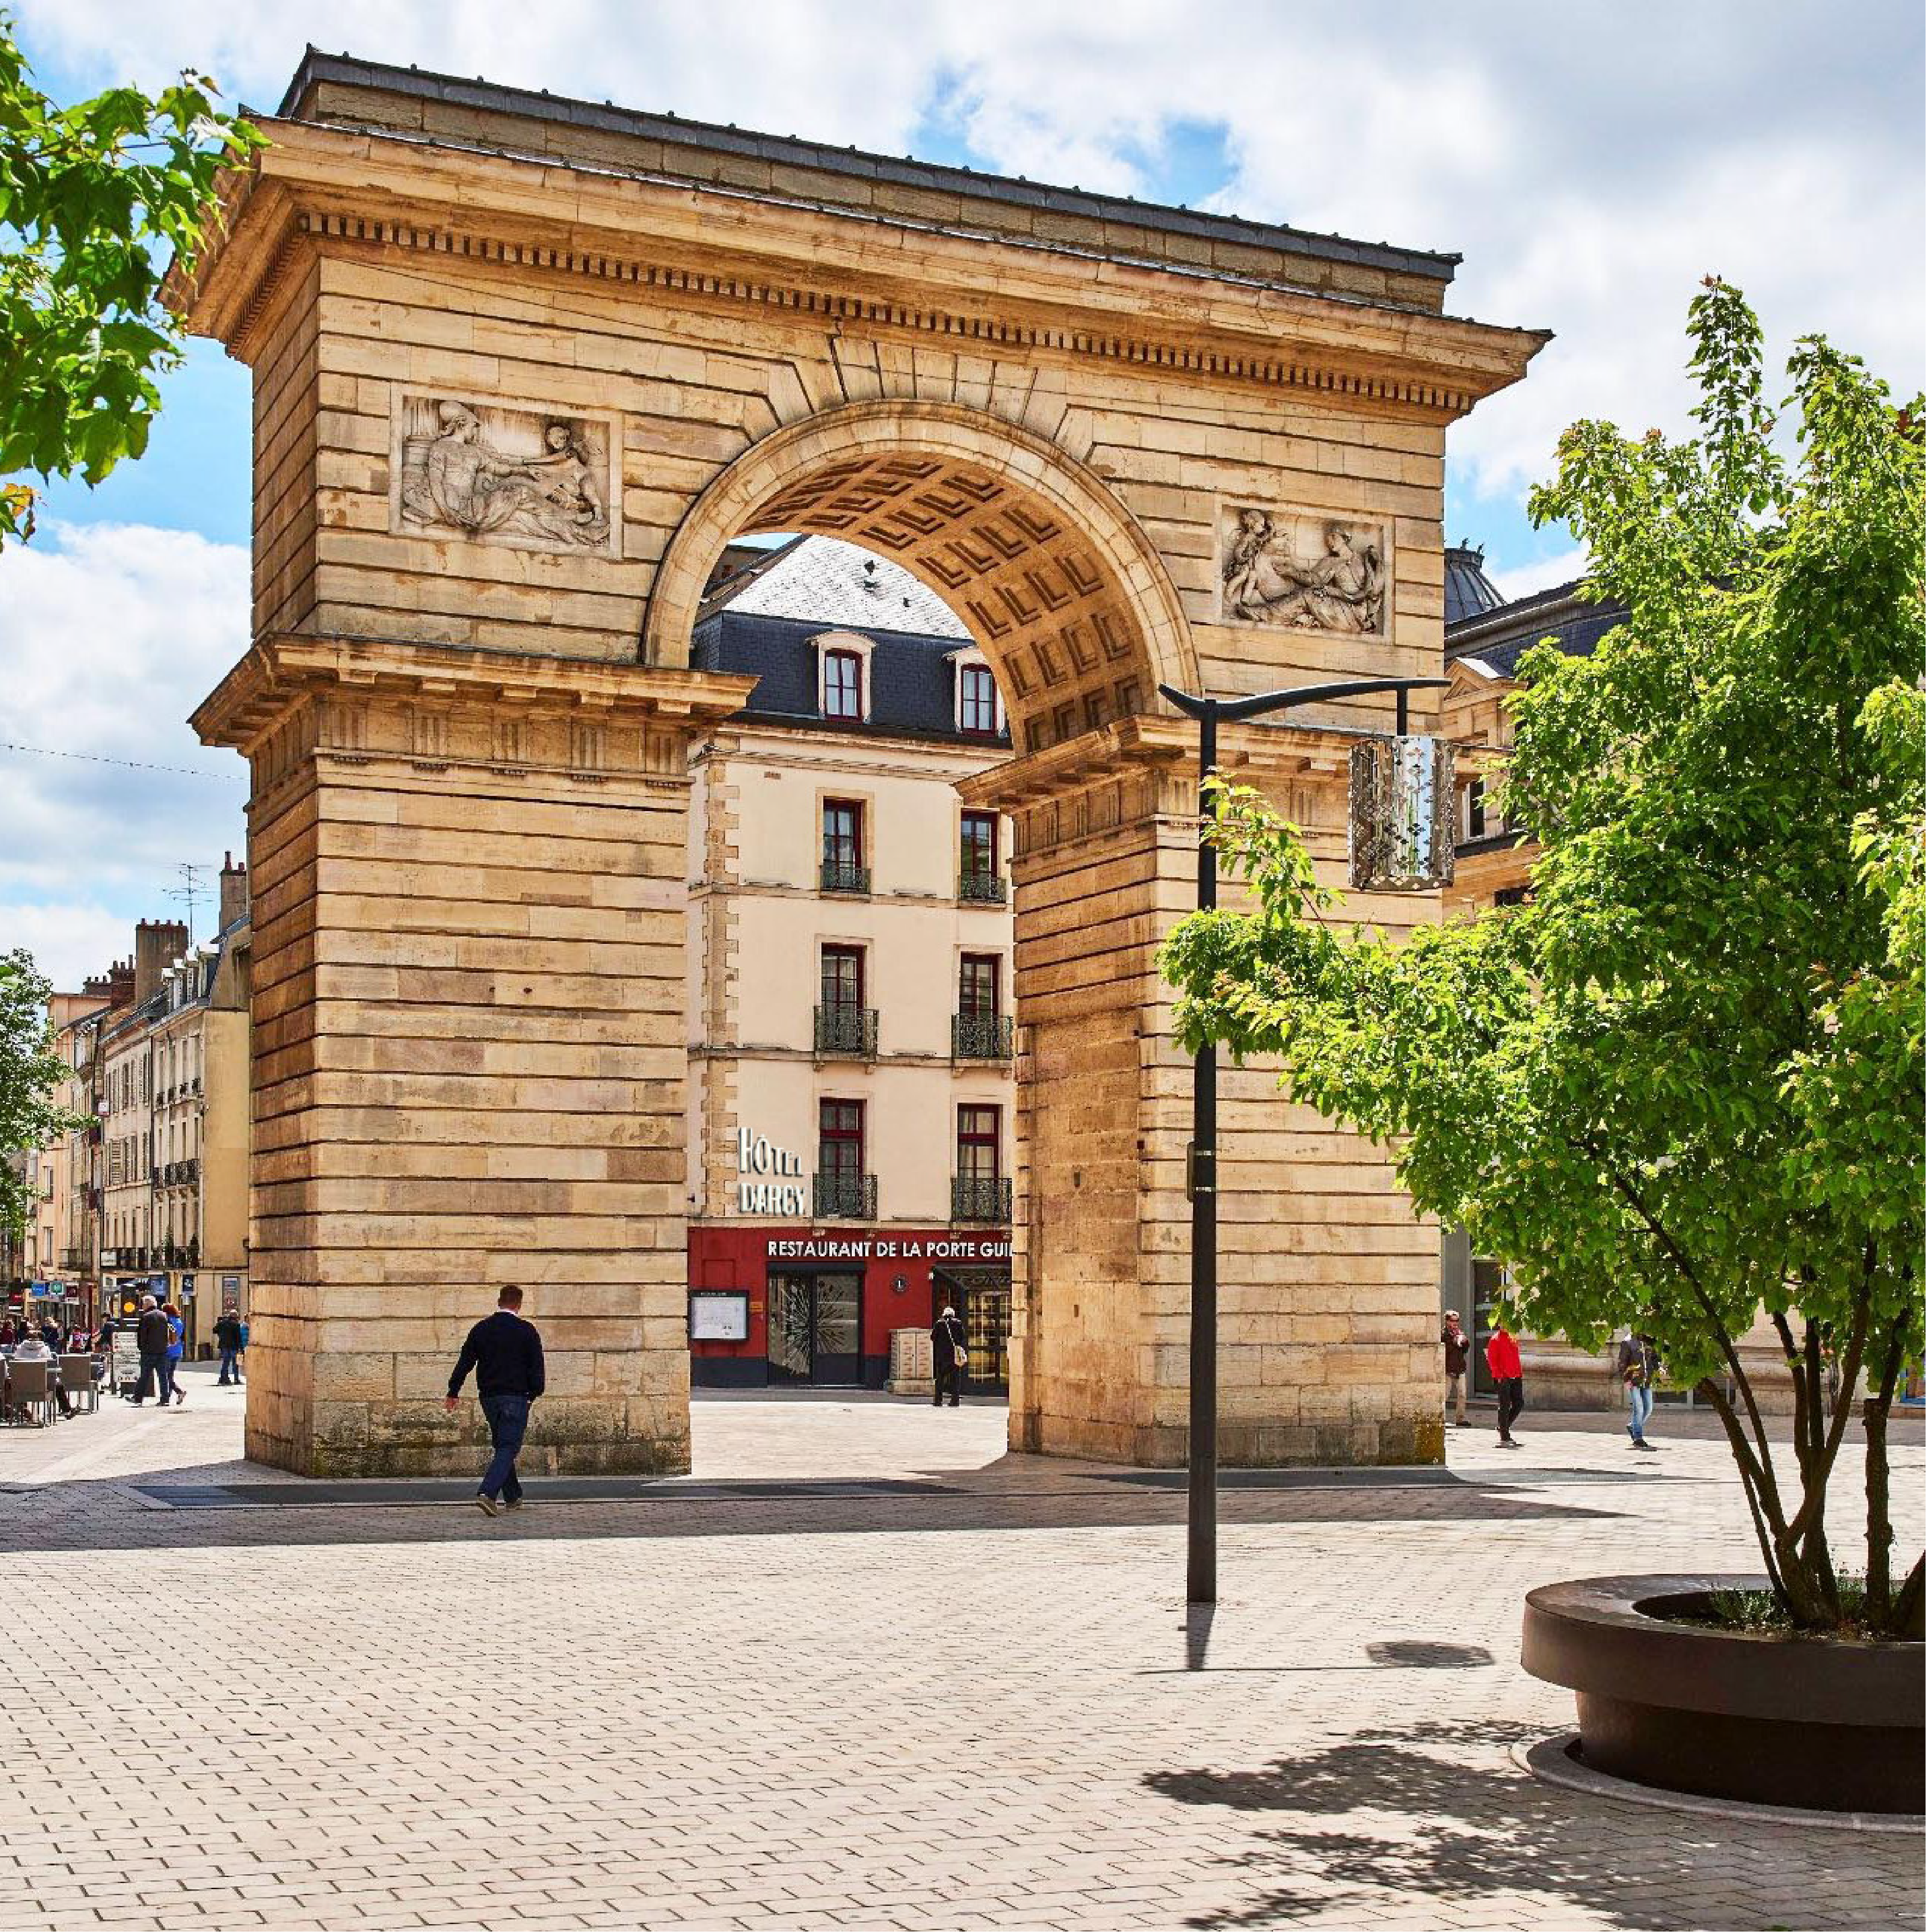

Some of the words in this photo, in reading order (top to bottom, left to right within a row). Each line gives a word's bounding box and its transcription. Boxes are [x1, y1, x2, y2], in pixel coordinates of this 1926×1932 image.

[739, 1127, 803, 1176] HÔTEL
[739, 1183, 805, 1216] DARCY
[768, 1241, 872, 1257] RESTAURANT
[877, 1241, 896, 1257] DE
[902, 1242, 922, 1257] LA
[927, 1242, 975, 1257] PORTE
